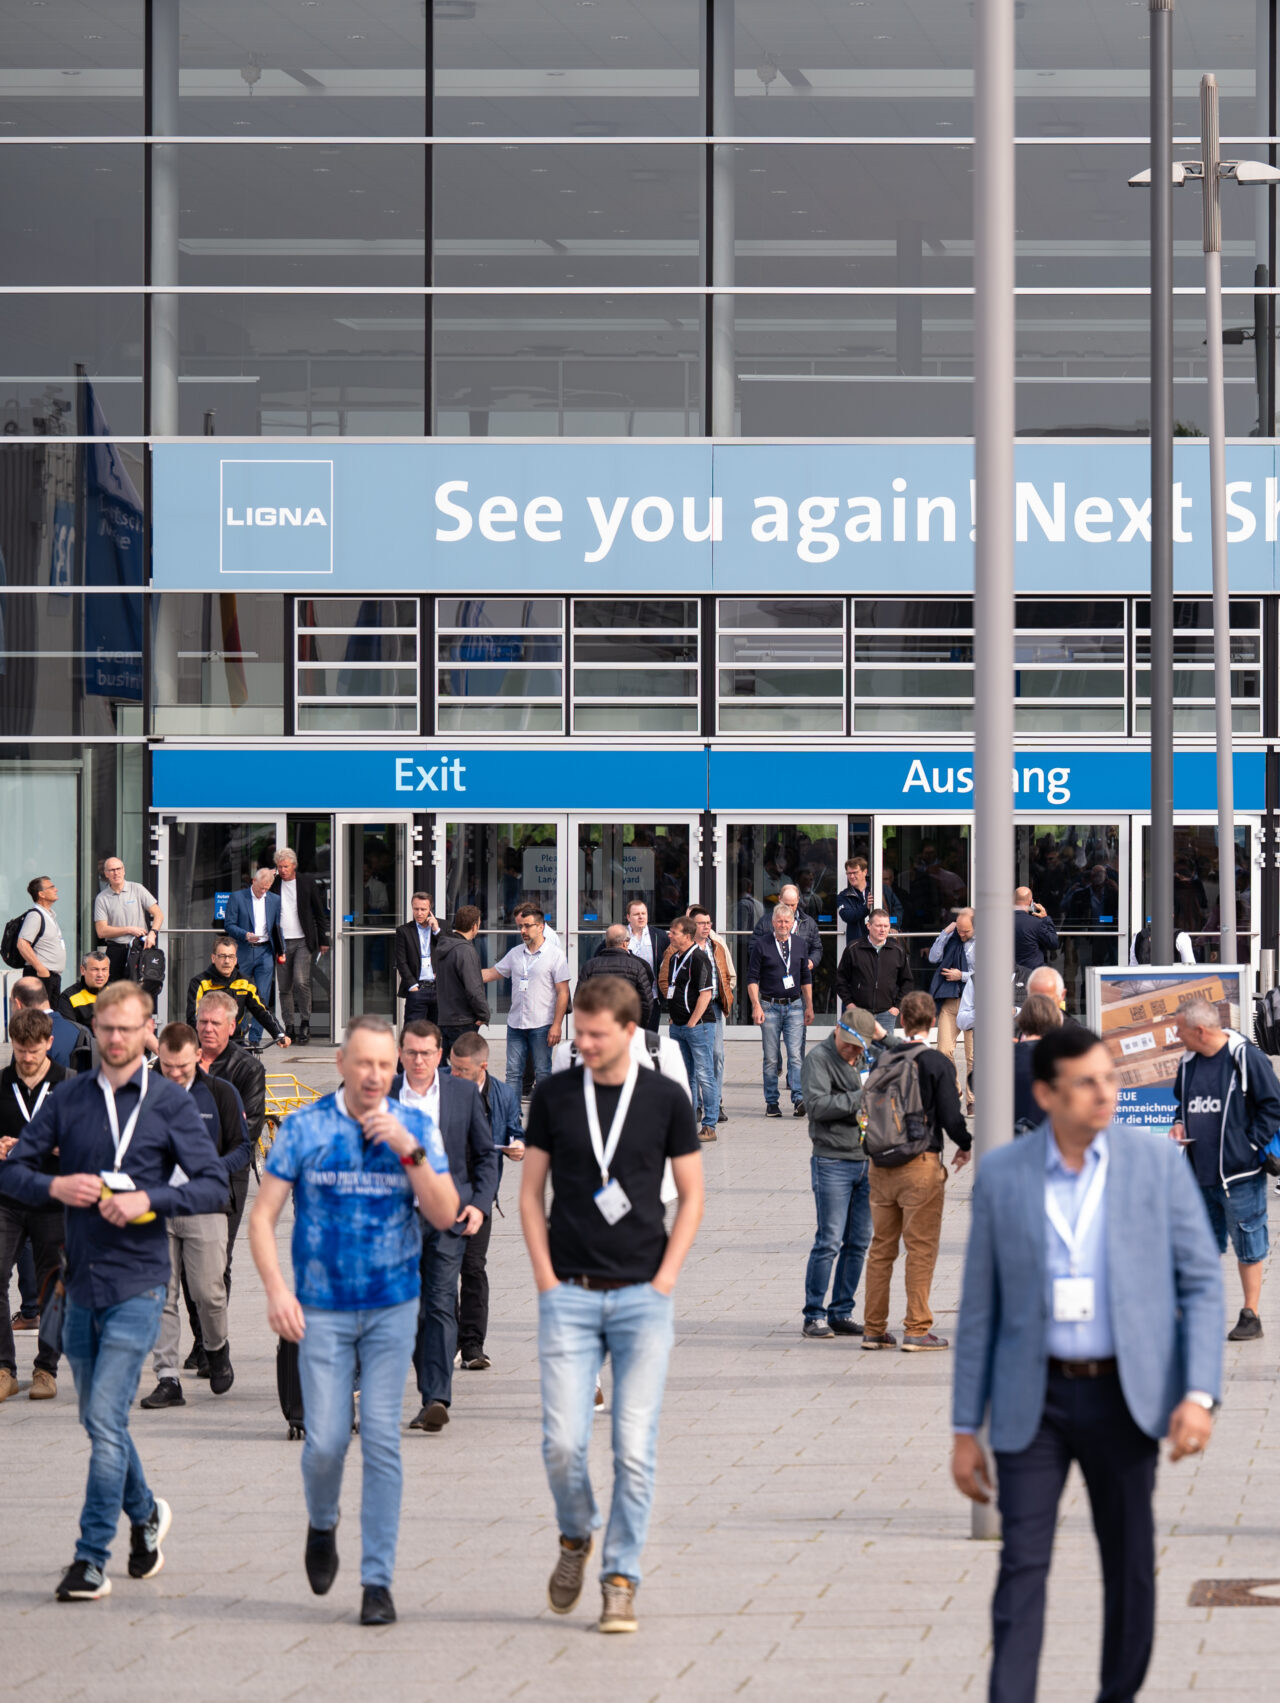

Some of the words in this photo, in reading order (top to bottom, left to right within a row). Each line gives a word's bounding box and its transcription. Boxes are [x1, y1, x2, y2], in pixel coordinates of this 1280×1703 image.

[226, 507, 327, 527] LIGNA
[434, 480, 563, 542] See
[583, 495, 723, 563] you
[1014, 481, 1194, 543] Next
[394, 756, 467, 792] Exit
[902, 759, 1071, 805] Ausng
[541, 854, 557, 862] Plea
[535, 864, 553, 873] take
[624, 866, 643, 874] your
[538, 875, 557, 885] Lany
[622, 875, 640, 885] yard
[1117, 1091, 1137, 1101] EUE
[1188, 1096, 1221, 1113] dida
[1126, 1113, 1142, 1124] die
